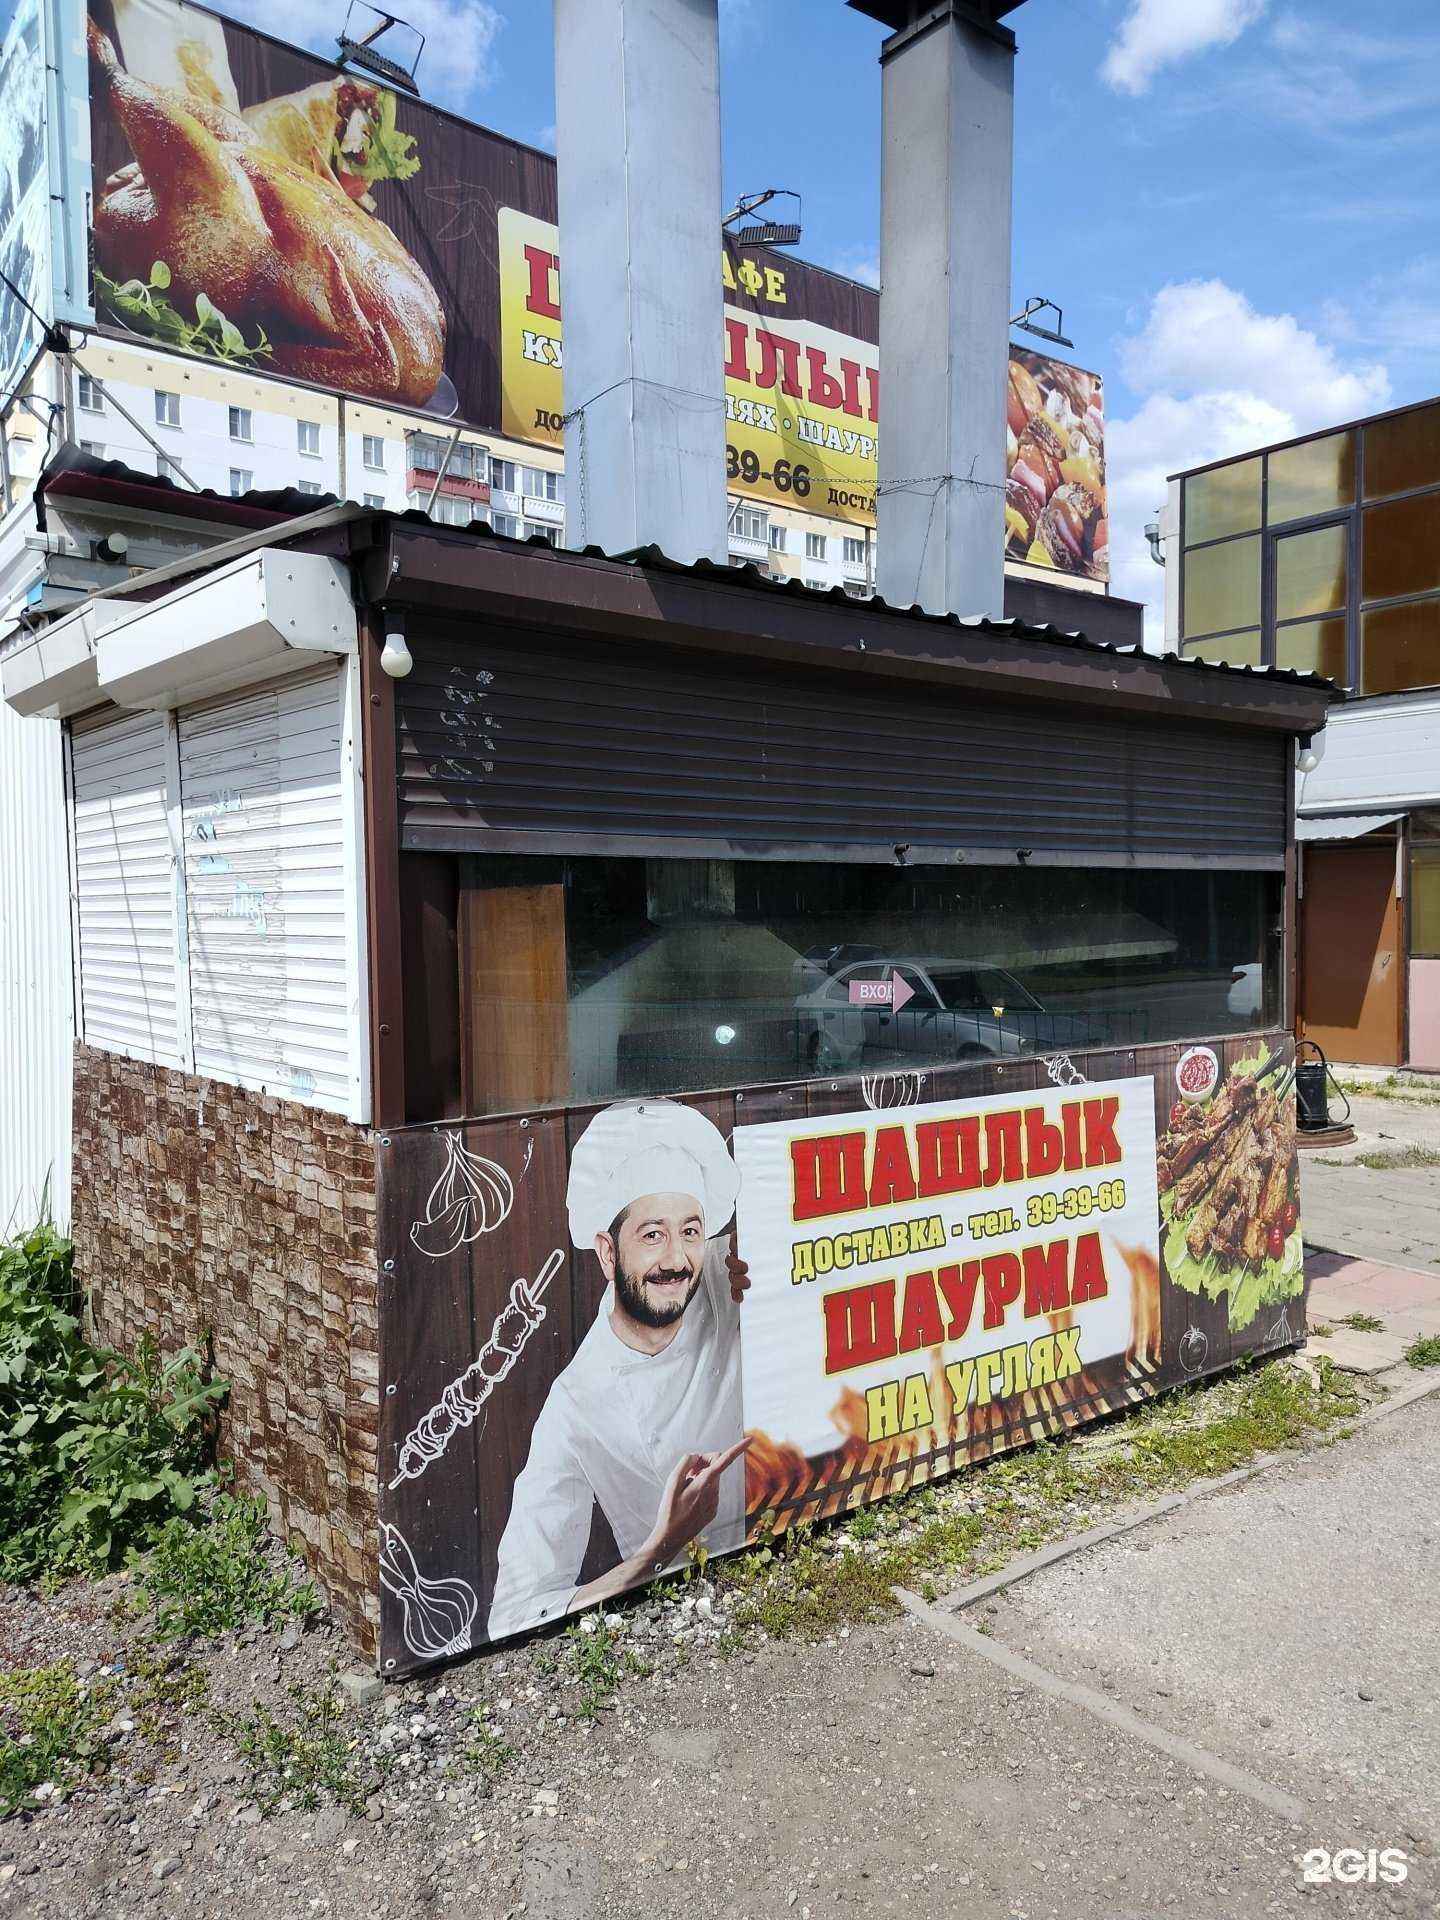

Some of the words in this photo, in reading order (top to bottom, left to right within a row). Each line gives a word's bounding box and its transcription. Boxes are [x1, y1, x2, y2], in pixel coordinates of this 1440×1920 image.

[797, 415, 879, 463] ШАУР
[788, 1096, 1124, 1223] ШАШЛЫК
[791, 1216, 946, 1285] ДОСТАВКА
[968, 1208, 1020, 1240] тел.
[1026, 1179, 1126, 1227] 39-39-66
[822, 1231, 1108, 1375] ШАУРМА
[865, 1372, 934, 1444] НА
[945, 1325, 1083, 1416] УГЛЯХ
